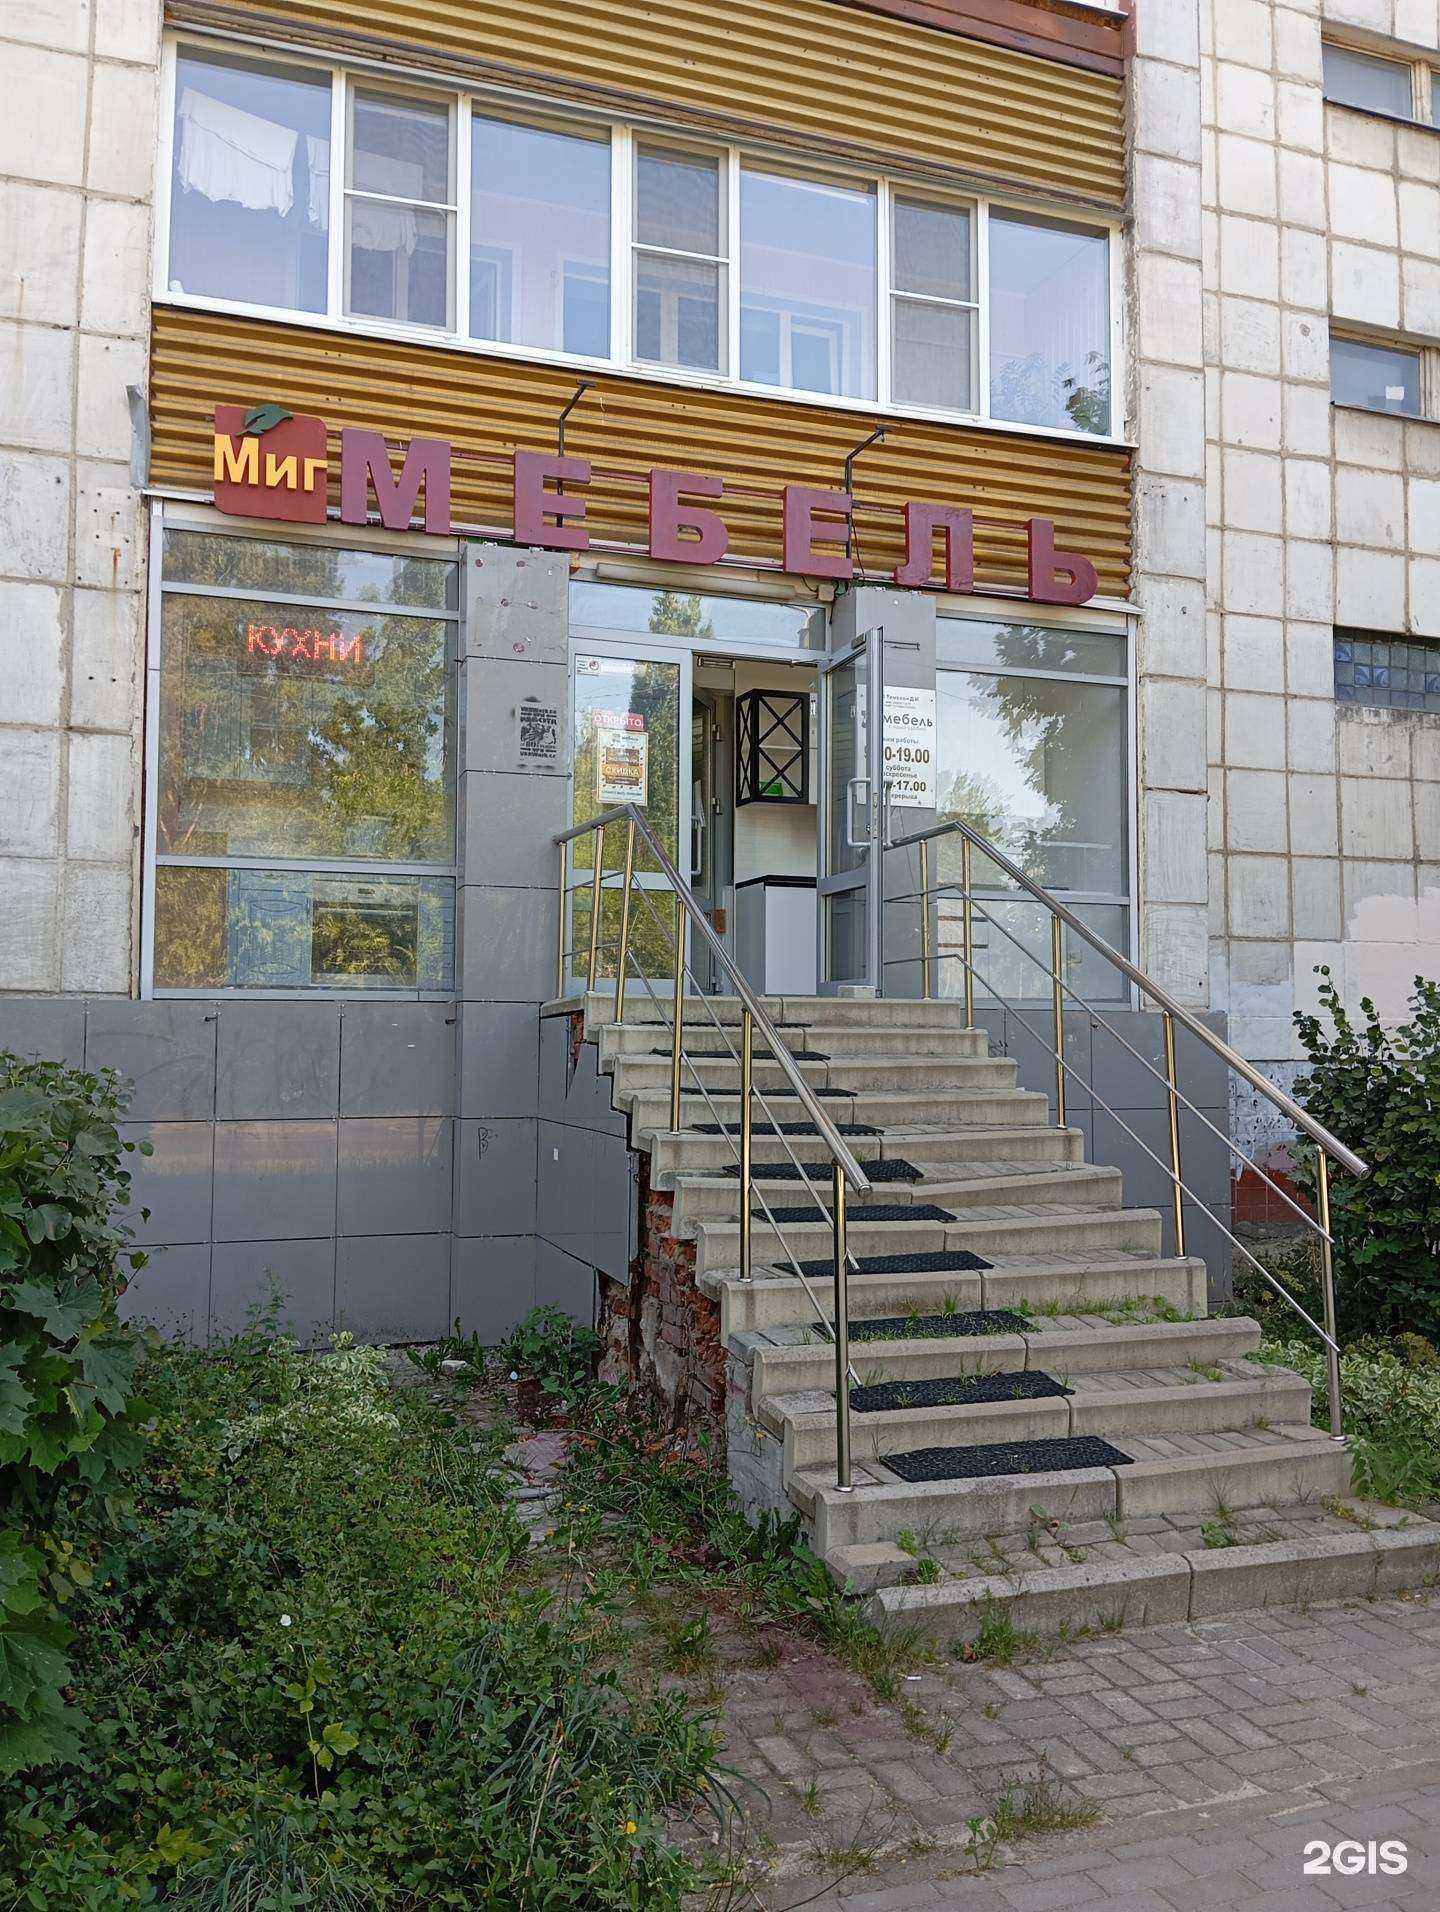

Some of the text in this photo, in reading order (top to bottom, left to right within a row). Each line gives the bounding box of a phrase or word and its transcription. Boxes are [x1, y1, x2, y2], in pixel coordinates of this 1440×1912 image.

[215, 428, 1099, 606] Миг МЕБЕЛЬ
[247, 623, 362, 663] КУХНИ
[594, 714, 642, 727] ОТКРЫТО
[883, 712, 933, 728] мебель
[884, 746, 930, 764] 0-19.00
[605, 765, 639, 777] СКИДКА
[883, 771, 918, 779] оскресенье
[885, 764, 911, 772] суббота
